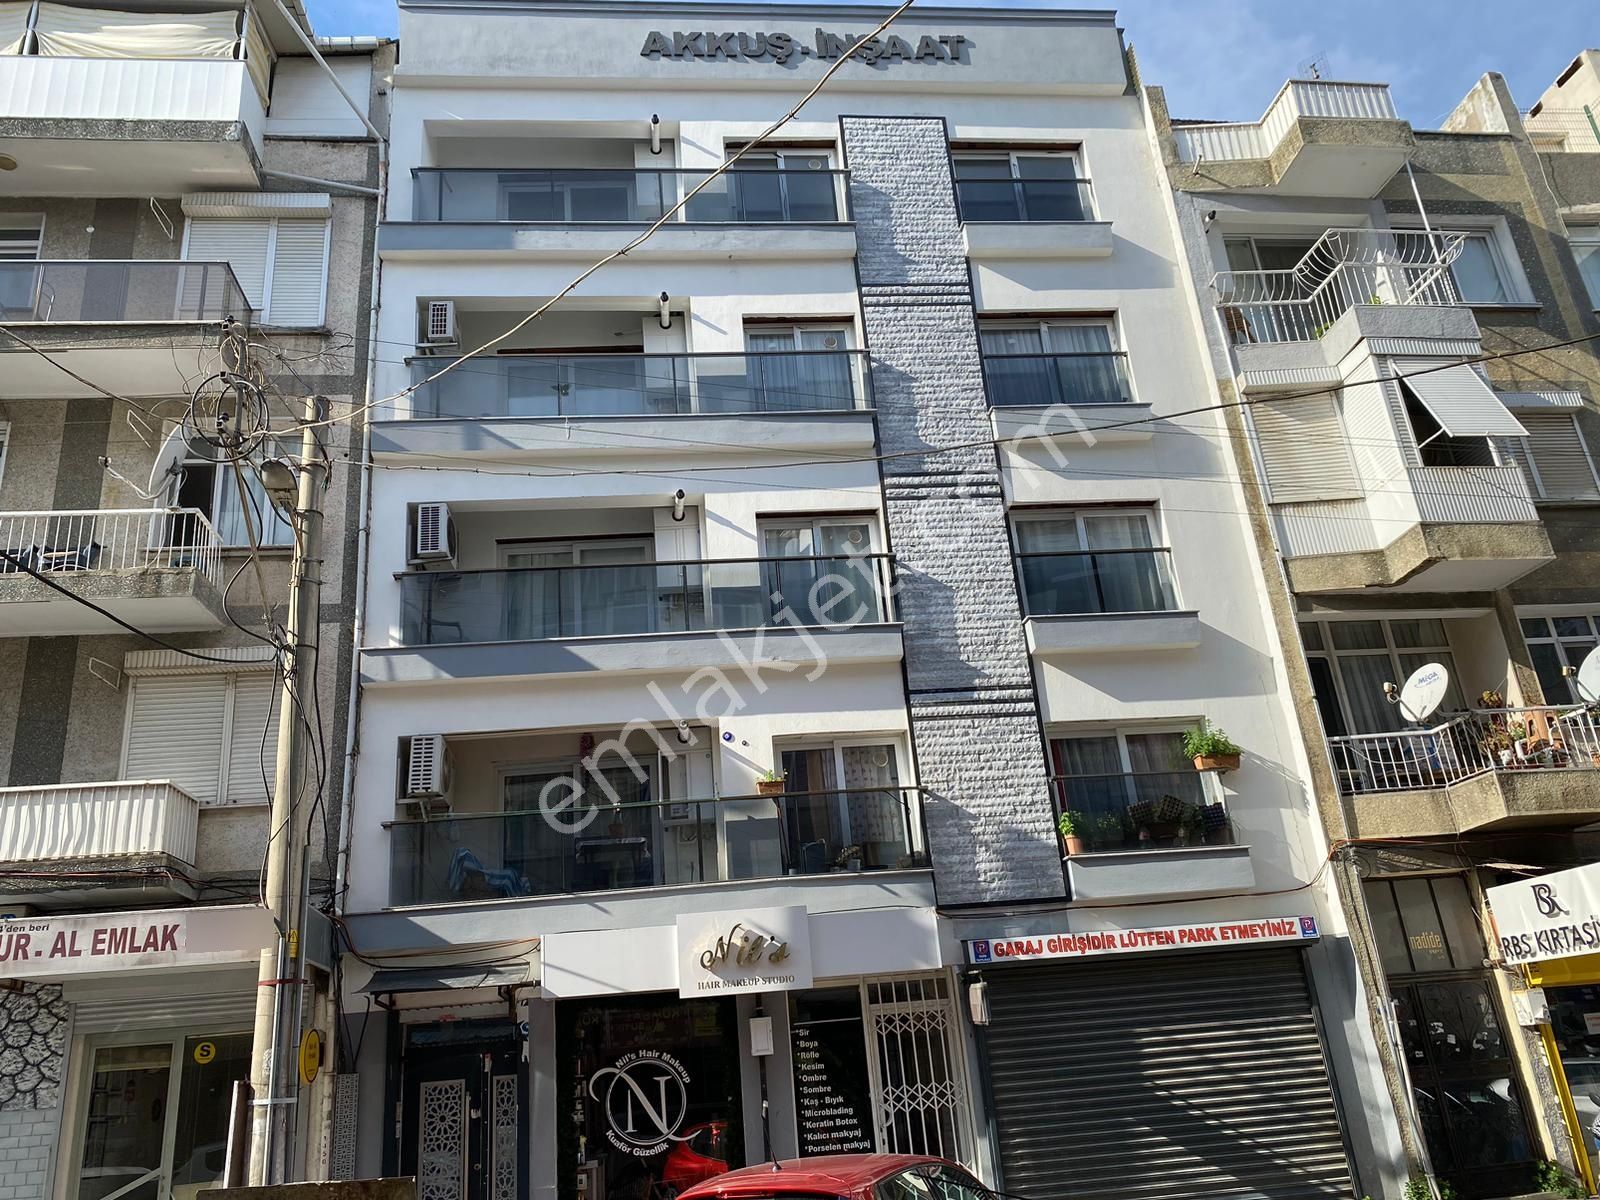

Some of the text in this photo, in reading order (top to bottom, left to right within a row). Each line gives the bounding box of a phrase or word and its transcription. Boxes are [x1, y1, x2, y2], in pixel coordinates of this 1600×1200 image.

[29, 923, 50, 932] beri
[1501, 914, 1600, 957] RBS KIRTASİ
[49, 930, 82, 958] AL
[90, 923, 181, 956] EMLAK
[699, 922, 791, 969] Nil's
[994, 918, 1297, 958] GARAJ GİRİŞİDİR LÜTFEN PARK ETMEYİNİZ
[1410, 931, 1442, 950] nadide
[697, 975, 795, 990] HAIR MAKEUP STUDIO
[615, 1049, 691, 1083] Nil's Hair Makeup
[835, 1117, 858, 1126] Botox
[830, 1128, 862, 1138] makyaj
[842, 1139, 871, 1151] makyaj
